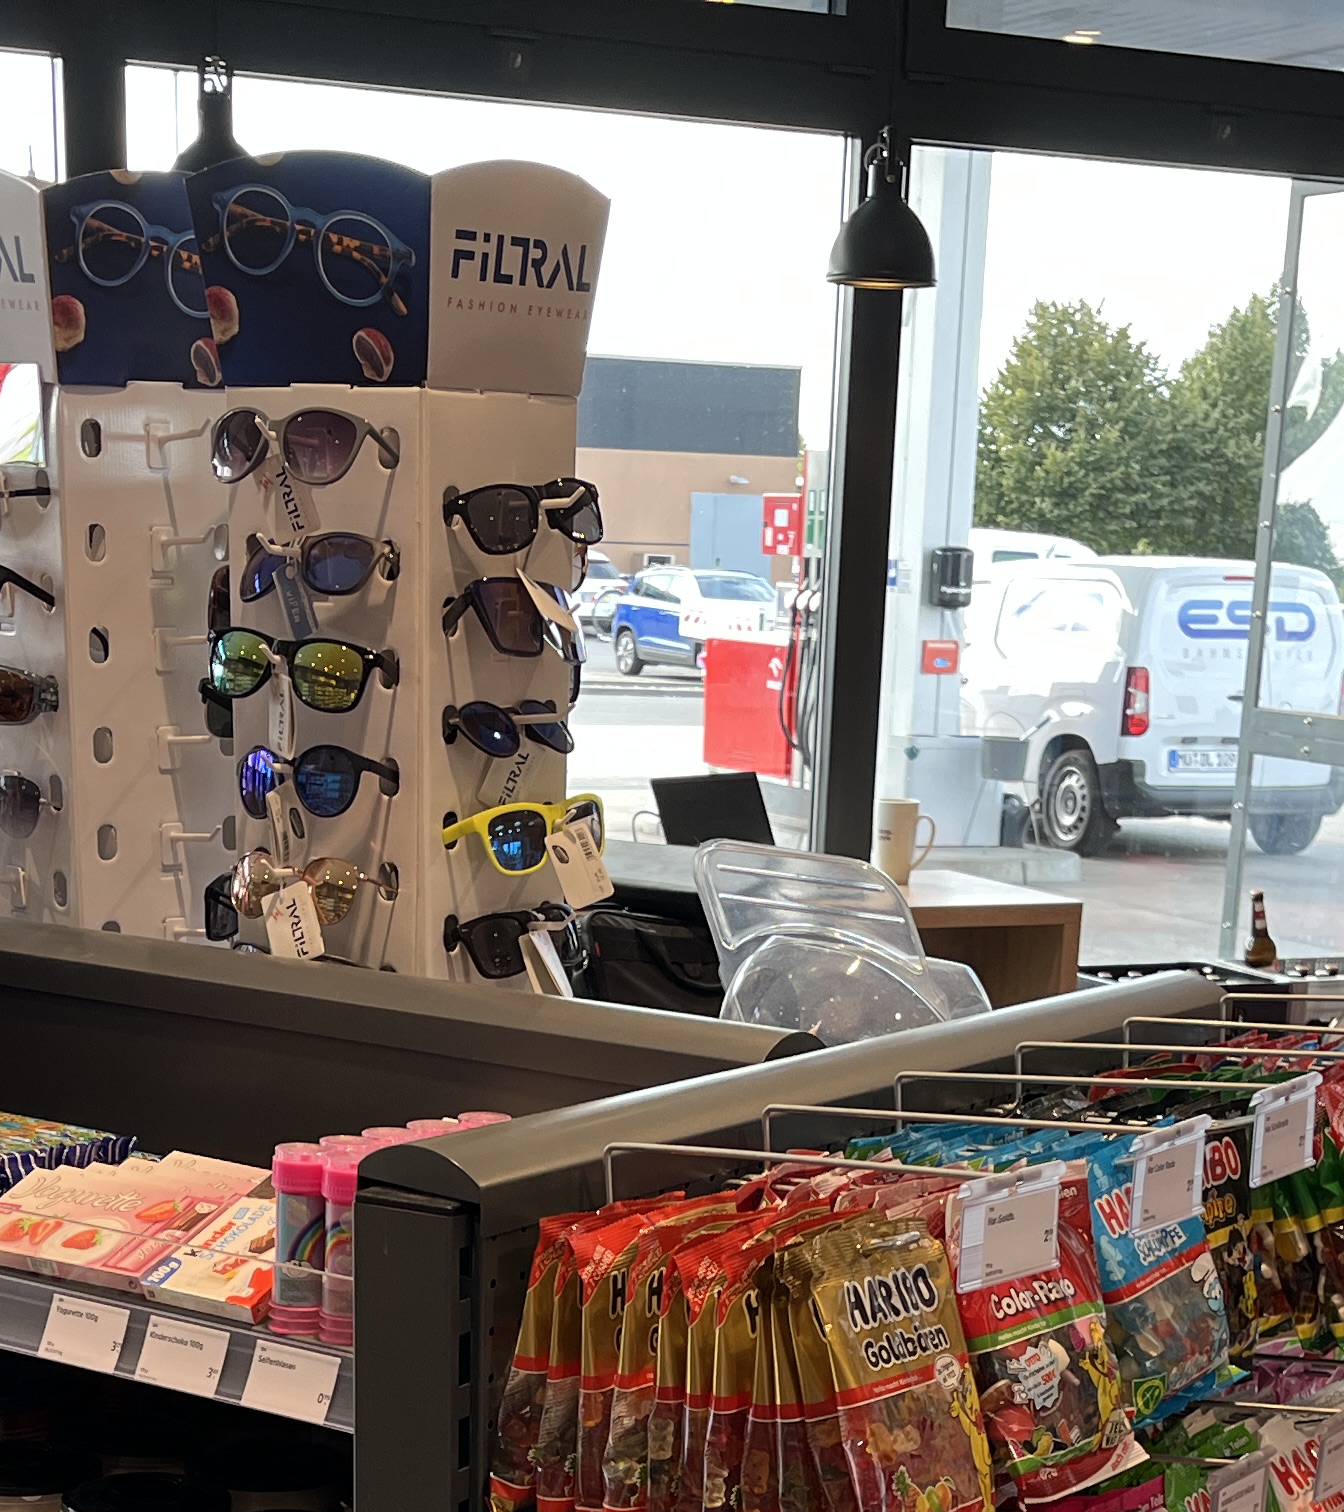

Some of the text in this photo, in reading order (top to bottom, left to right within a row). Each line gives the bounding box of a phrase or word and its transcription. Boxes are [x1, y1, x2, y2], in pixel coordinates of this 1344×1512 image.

[447, 296, 588, 321] FASHION EYEWEAR
[1177, 599, 1316, 642] ESD
[9, 1175, 145, 1214] Yogurette
[846, 1264, 939, 1333] HARIBO
[863, 1325, 951, 1371] Goldbären
